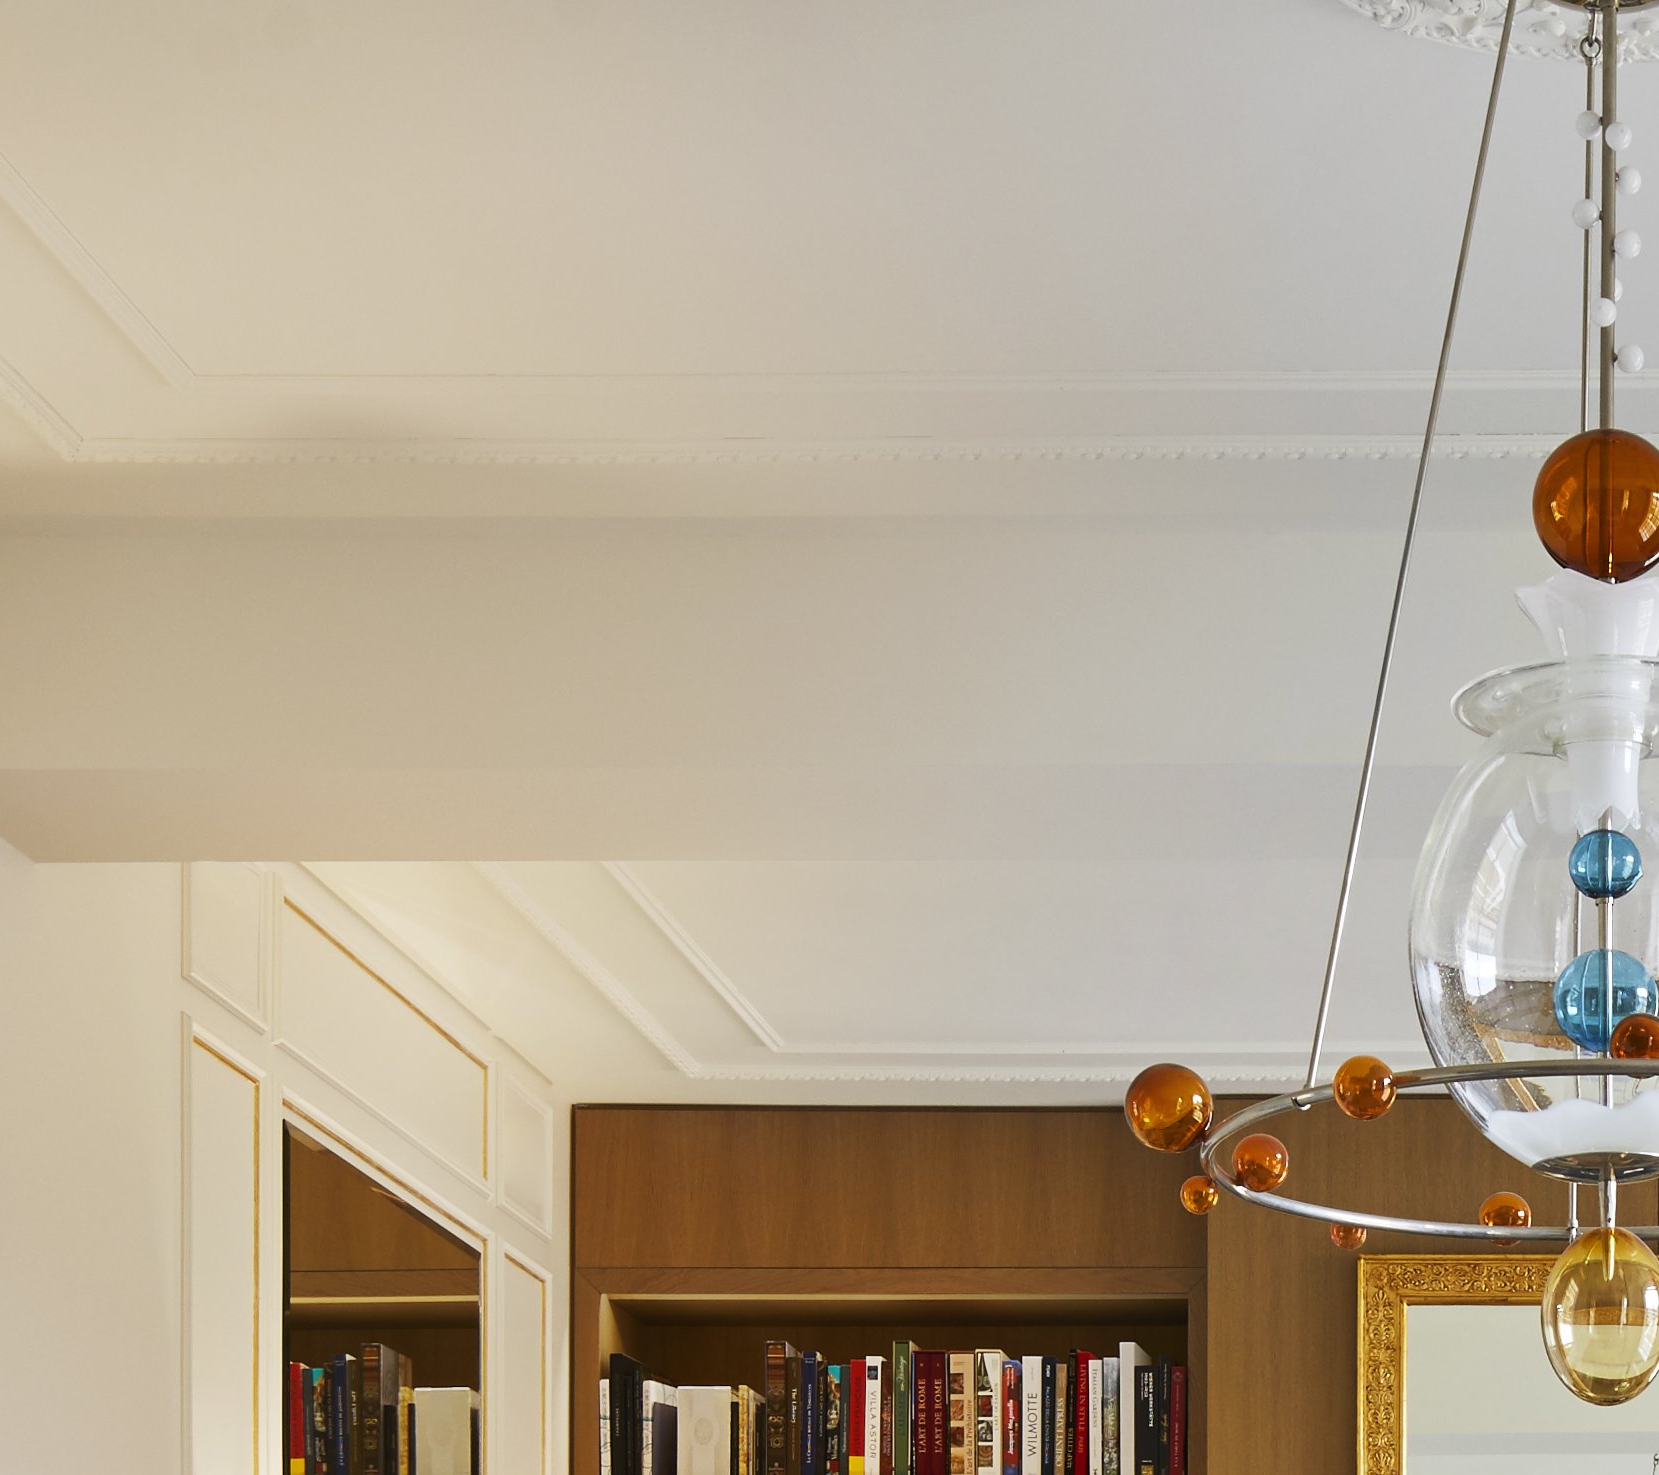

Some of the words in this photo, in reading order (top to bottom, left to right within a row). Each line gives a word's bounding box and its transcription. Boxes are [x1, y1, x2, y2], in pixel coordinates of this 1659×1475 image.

[869, 1391, 877, 1420] VILLA
[918, 1379, 927, 1408] ROME
[934, 1379, 943, 1408] ROME
[1079, 1395, 1086, 1404] IN
[918, 1412, 927, 1424] DE
[934, 1412, 943, 1424] DE
[1027, 1393, 1038, 1457] WILMOTTE
[869, 1424, 877, 1458] ASTOR
[918, 1428, 927, 1453] L'ART
[934, 1428, 943, 1453] L'ART
[966, 1449, 973, 1459] de
